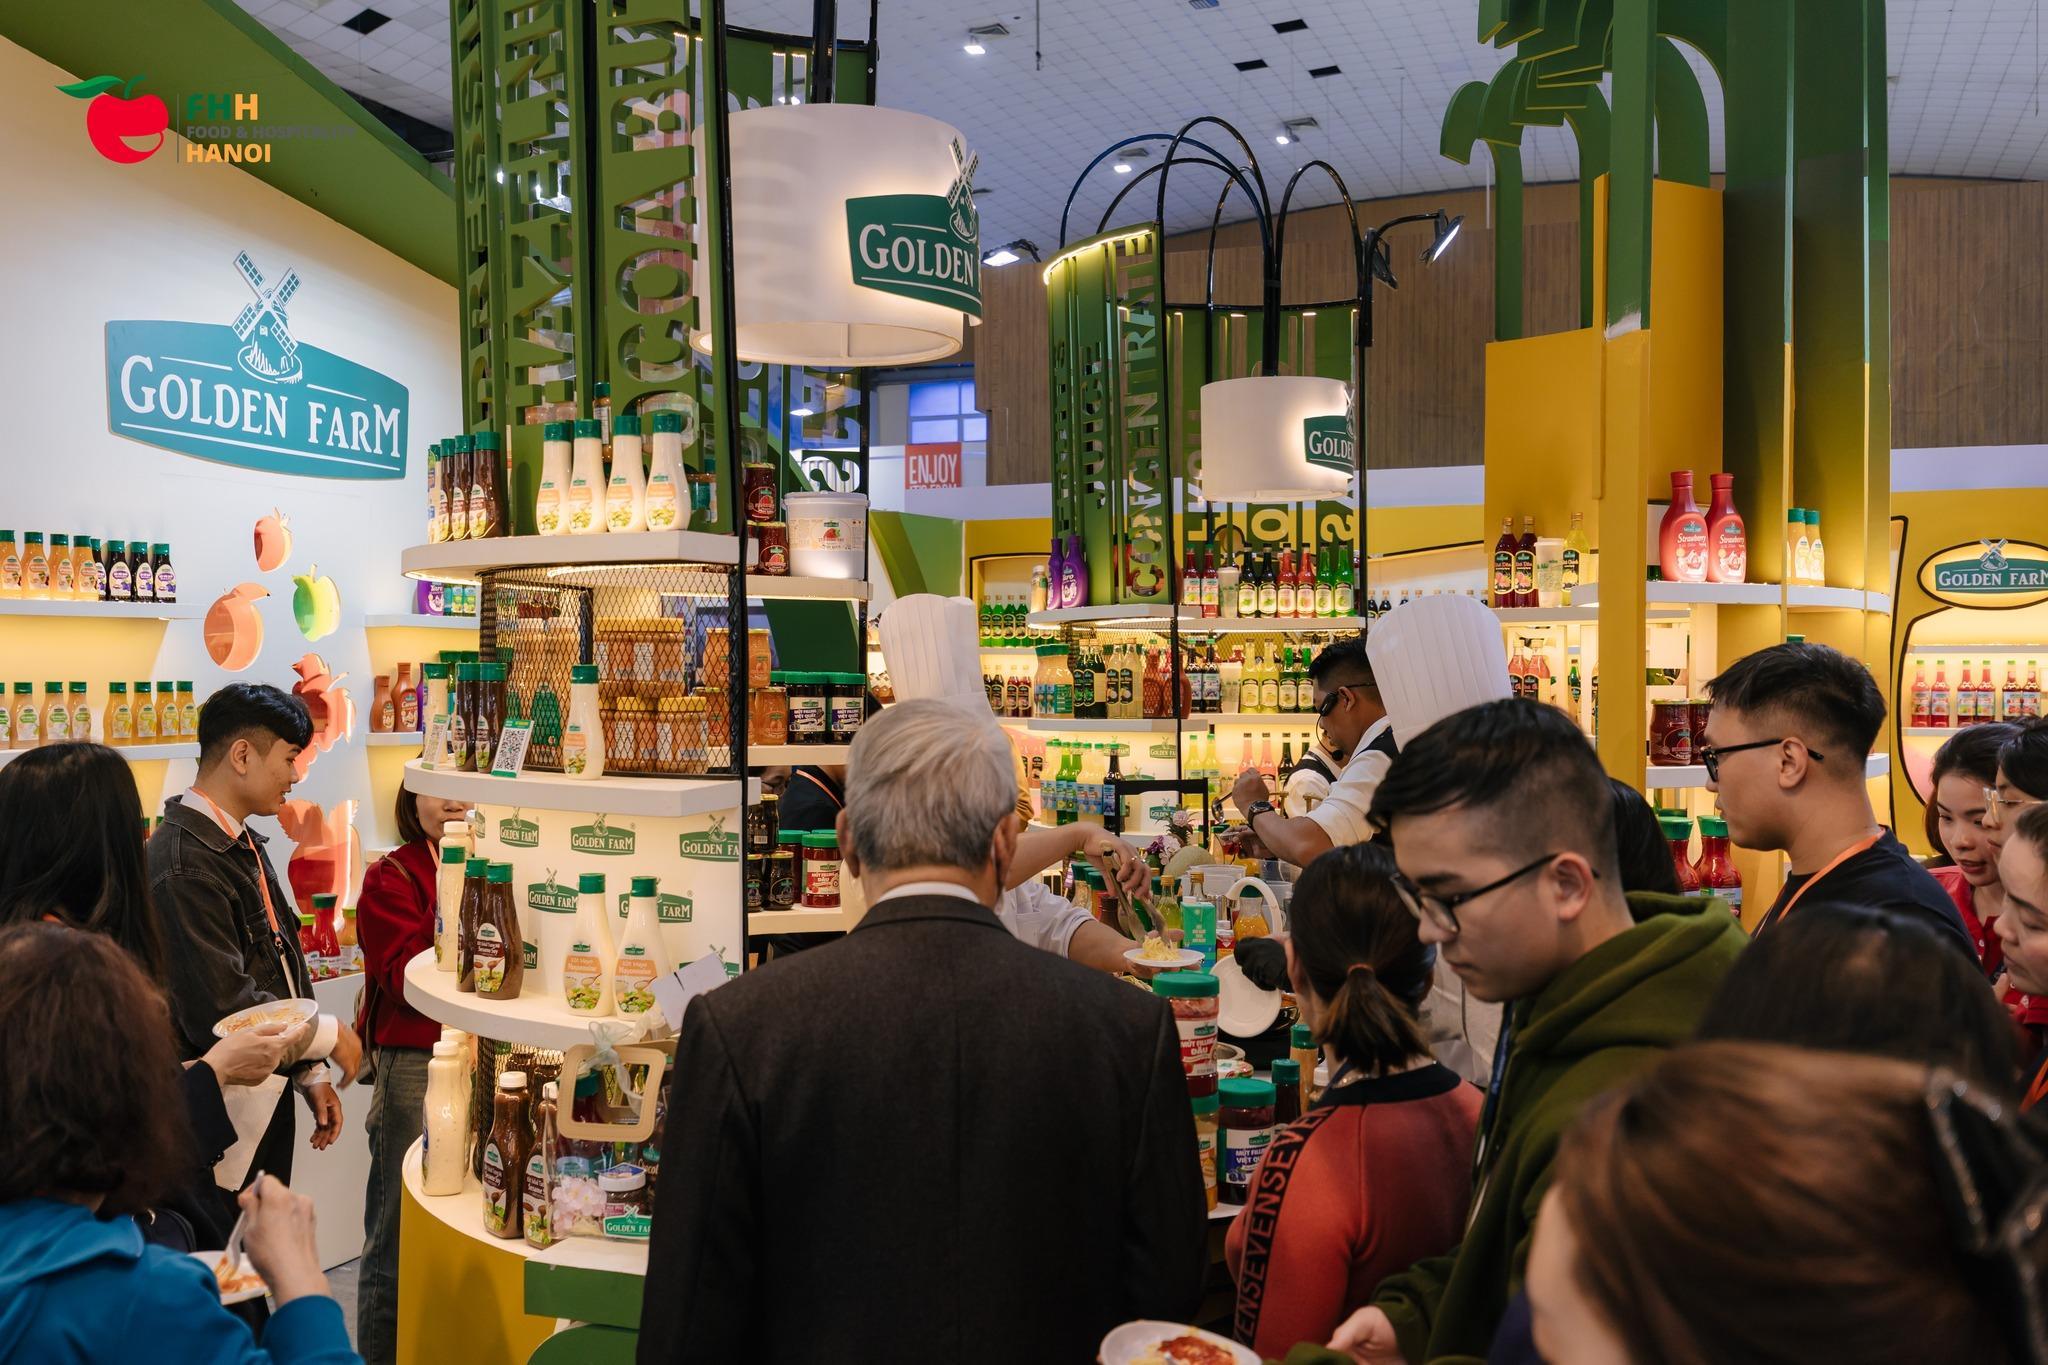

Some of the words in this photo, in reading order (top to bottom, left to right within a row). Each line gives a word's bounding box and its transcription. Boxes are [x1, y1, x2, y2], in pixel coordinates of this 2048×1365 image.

[859, 223, 974, 288] GOLDEN
[120, 354, 288, 438] GOLDEN
[308, 401, 401, 458] FARM
[908, 453, 958, 485] ENJOY
[1938, 570, 2002, 587] GOLDEN
[500, 826, 520, 841] GOLDEN
[521, 829, 538, 843] FARM
[572, 833, 605, 849] GOLDEN
[608, 834, 634, 850] FARM
[681, 841, 723, 856] GOLDEN
[529, 893, 556, 907] GOLDEN
[663, 904, 690, 919] FARM
[606, 1222, 636, 1233] GOLDEN
